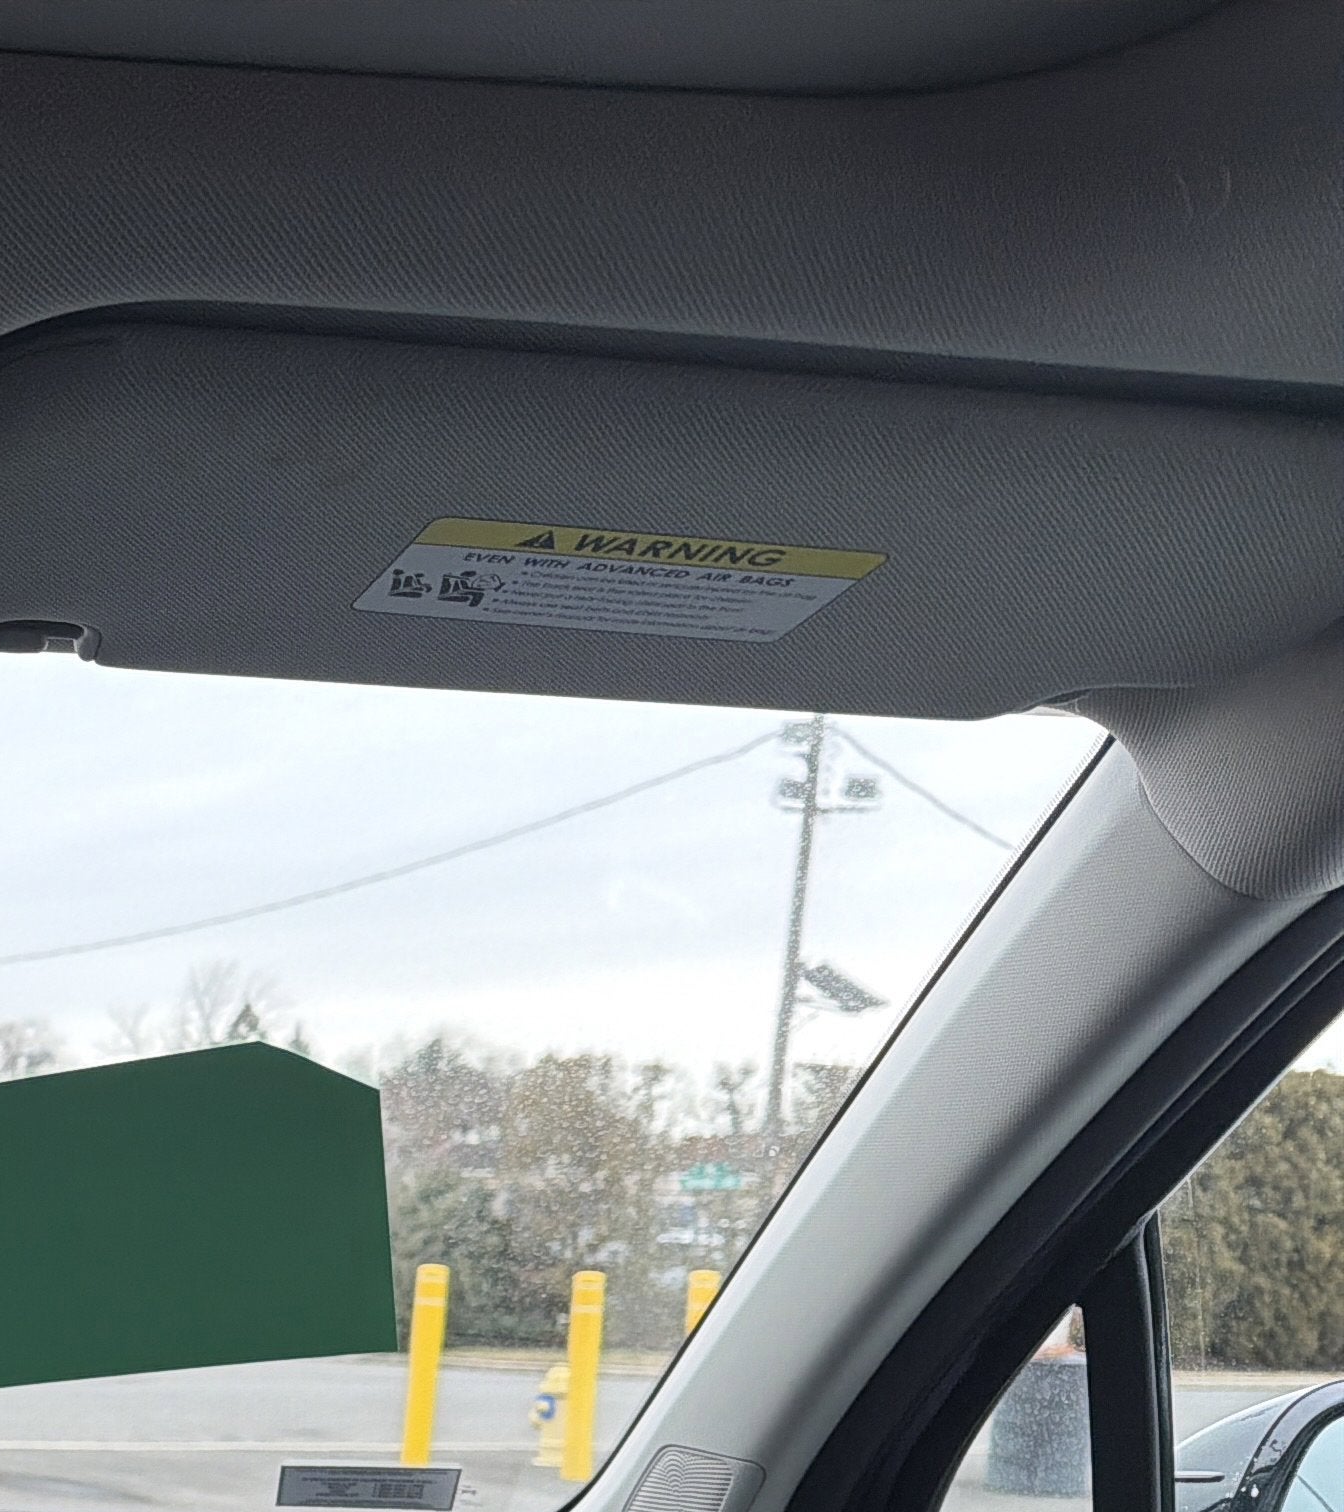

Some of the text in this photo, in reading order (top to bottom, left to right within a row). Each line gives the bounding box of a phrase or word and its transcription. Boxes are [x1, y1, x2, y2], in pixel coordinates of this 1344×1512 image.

[574, 533, 787, 567] WARNING
[464, 552, 796, 588] EVEN WITH ADVANCED AIR BAGS
